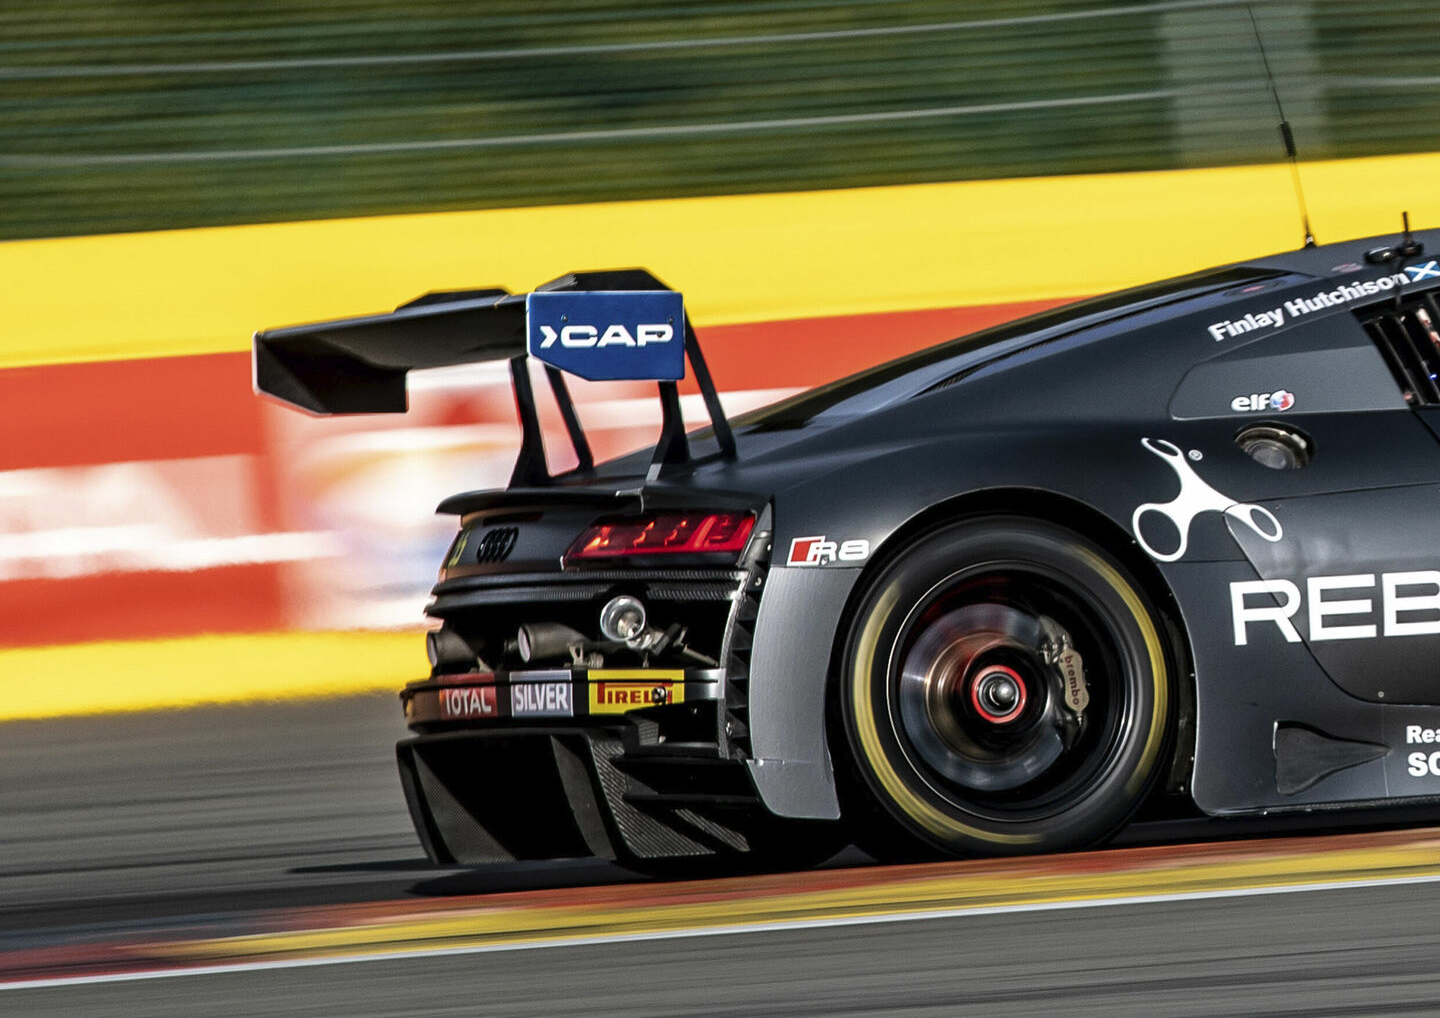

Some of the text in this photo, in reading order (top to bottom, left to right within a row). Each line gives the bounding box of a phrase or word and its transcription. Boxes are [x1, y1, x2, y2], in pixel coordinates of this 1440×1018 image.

[1207, 272, 1412, 342] Finlay Hutchison
[1230, 393, 1271, 412] elf
[802, 537, 870, 564] R8
[597, 678, 674, 705] PIRELI
[1063, 655, 1081, 706] brembo
[444, 687, 492, 716] TOTAL
[513, 684, 568, 713] SILVER
